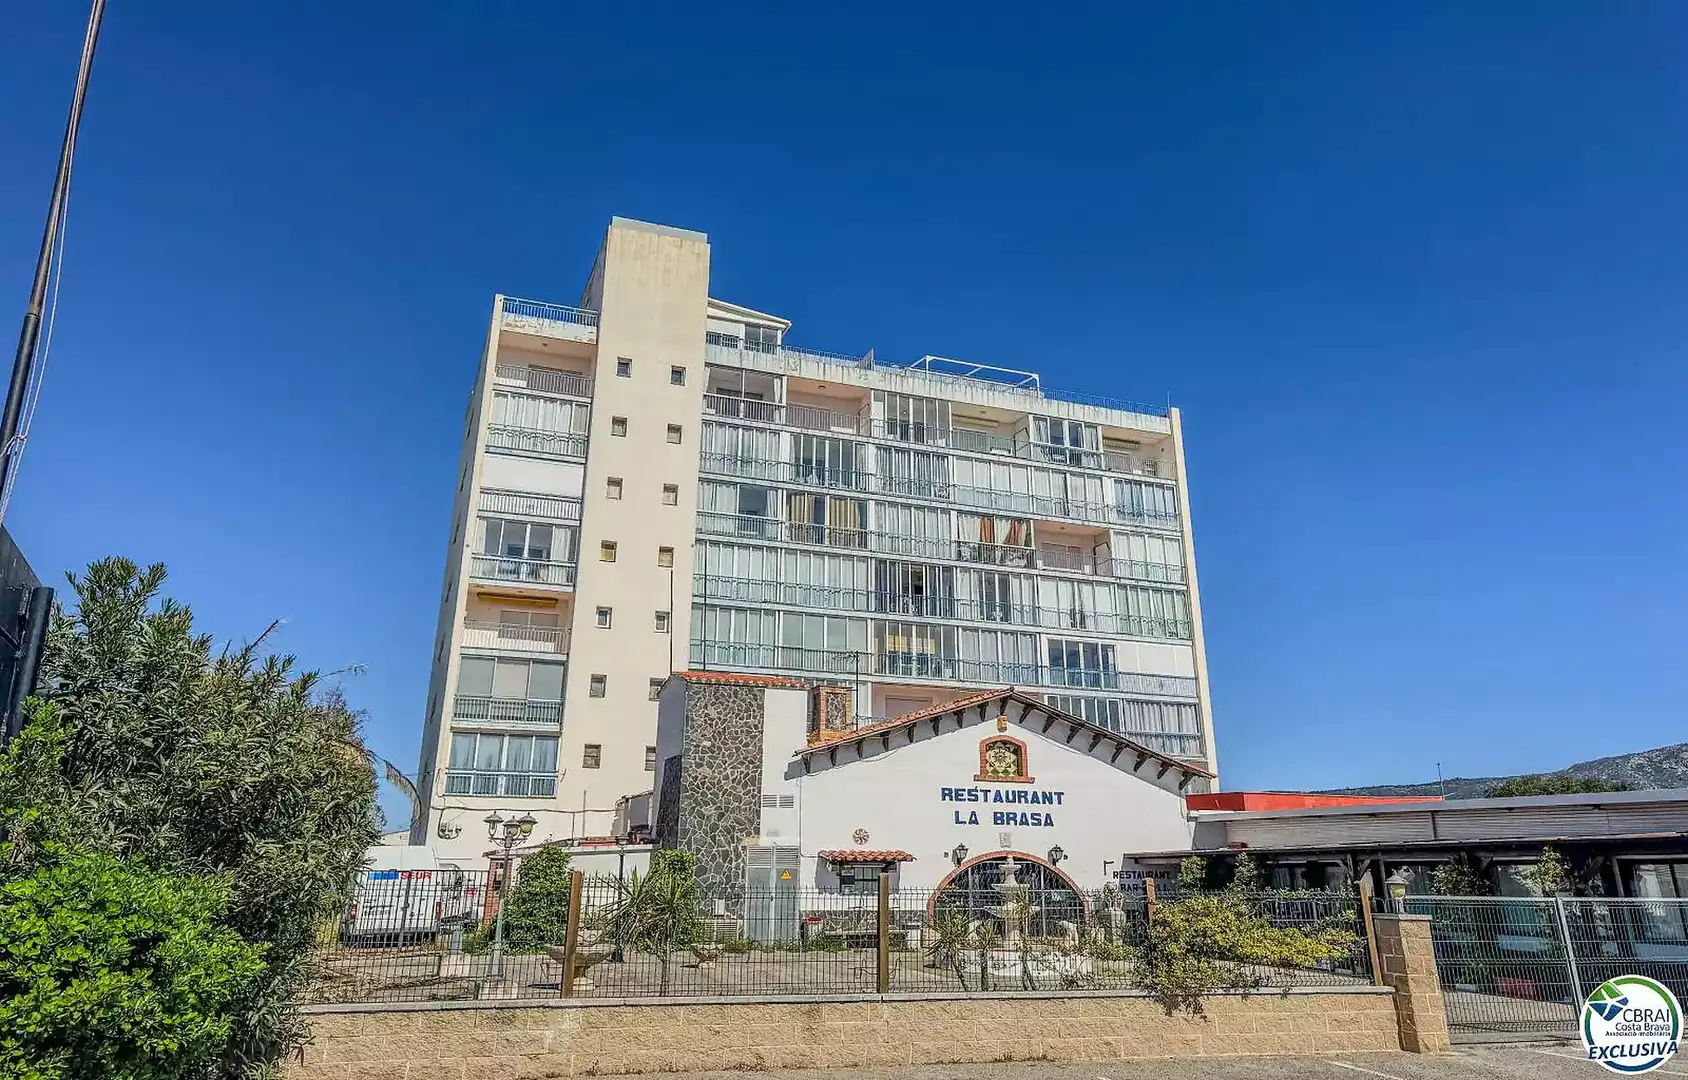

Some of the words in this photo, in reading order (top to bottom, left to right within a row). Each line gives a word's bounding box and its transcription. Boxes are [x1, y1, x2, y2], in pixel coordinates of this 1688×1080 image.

[941, 787, 1065, 805] RESTAURANT
[955, 811, 979, 825] LA
[993, 811, 1054, 827] BRASA
[401, 871, 431, 880] SEUR
